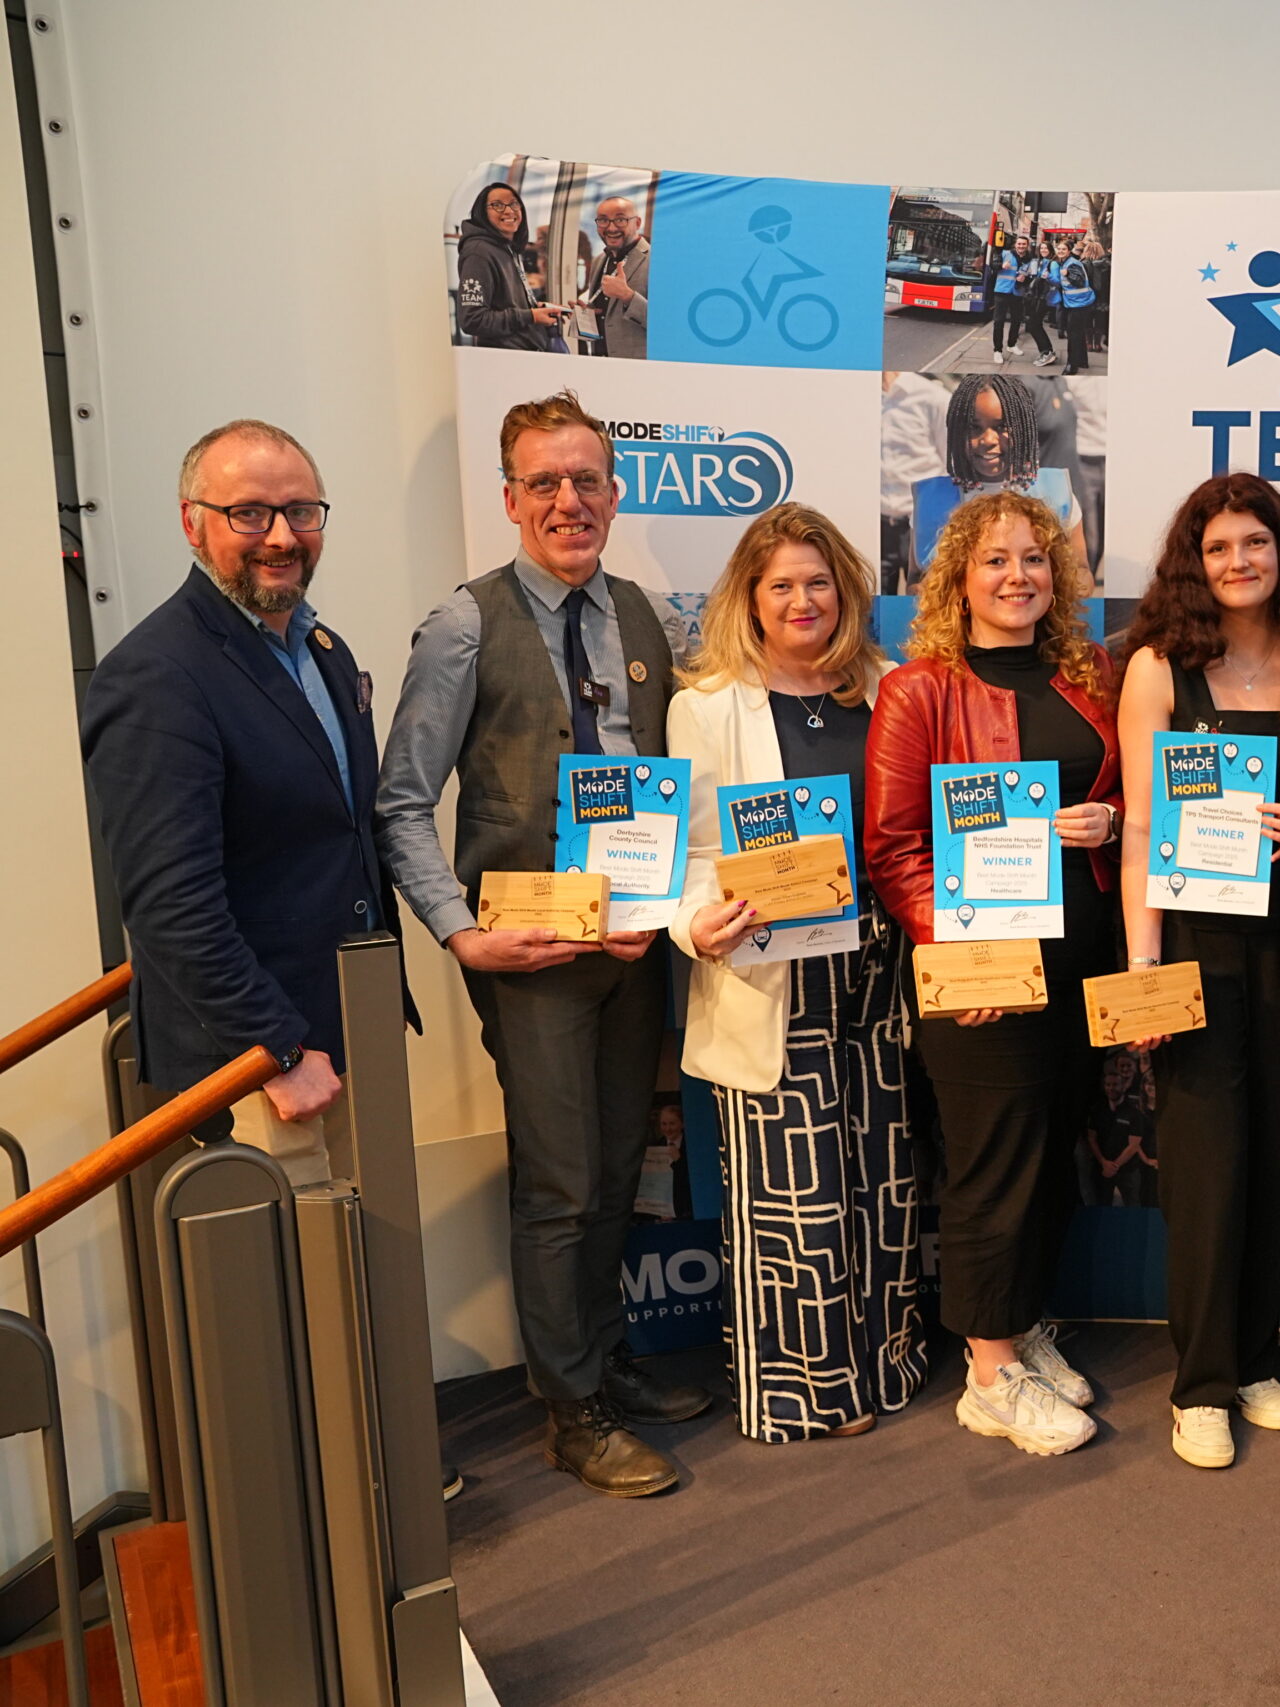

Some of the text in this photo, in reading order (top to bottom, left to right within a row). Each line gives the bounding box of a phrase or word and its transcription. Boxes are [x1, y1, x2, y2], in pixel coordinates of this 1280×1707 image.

[461, 293, 484, 303] TEAM
[1170, 757, 1214, 772] MODE
[1172, 769, 1216, 785] SHIFT
[578, 779, 625, 795] MODE
[1172, 783, 1217, 796] MONTH
[580, 792, 626, 808] SHIFT
[951, 786, 997, 804] MODE
[580, 805, 628, 818] MONTH
[739, 804, 788, 826] MODE
[952, 800, 998, 817] SHIFT
[954, 812, 1000, 828] MONTH
[617, 829, 651, 837] Derbyshire
[742, 817, 789, 839] SHIFT
[1197, 826, 1245, 840] WINNER
[609, 835, 631, 843] County
[744, 830, 793, 850] MONTH
[607, 849, 657, 861] WINNER
[982, 857, 1032, 866] WINNER
[1202, 858, 1232, 867] Residential
[628, 1301, 722, 1323] UPPORTI
